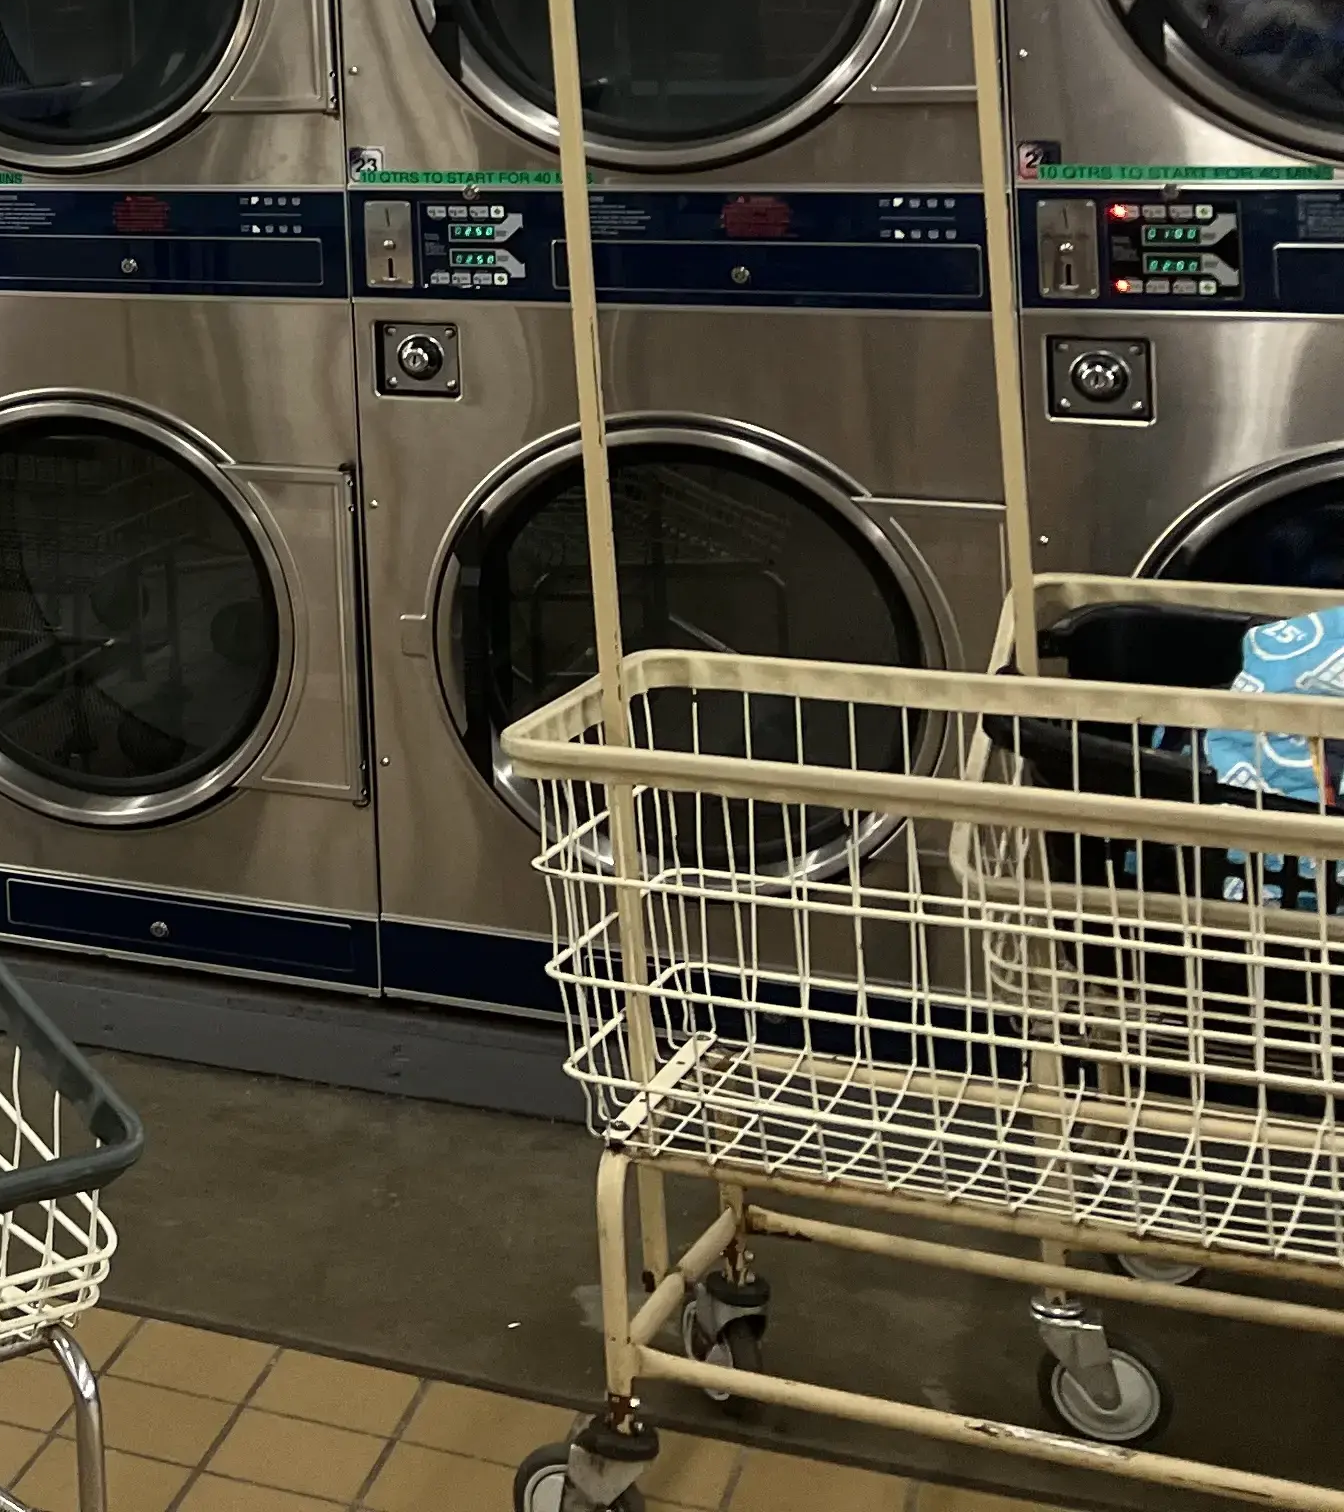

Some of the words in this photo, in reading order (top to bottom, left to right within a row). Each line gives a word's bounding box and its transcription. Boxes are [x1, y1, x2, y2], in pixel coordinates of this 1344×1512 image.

[362, 172, 376, 184] 10
[380, 172, 419, 184] QTRS
[423, 172, 441, 184] TO
[447, 172, 495, 184] START
[500, 172, 530, 184] FOR
[534, 172, 551, 184] 40
